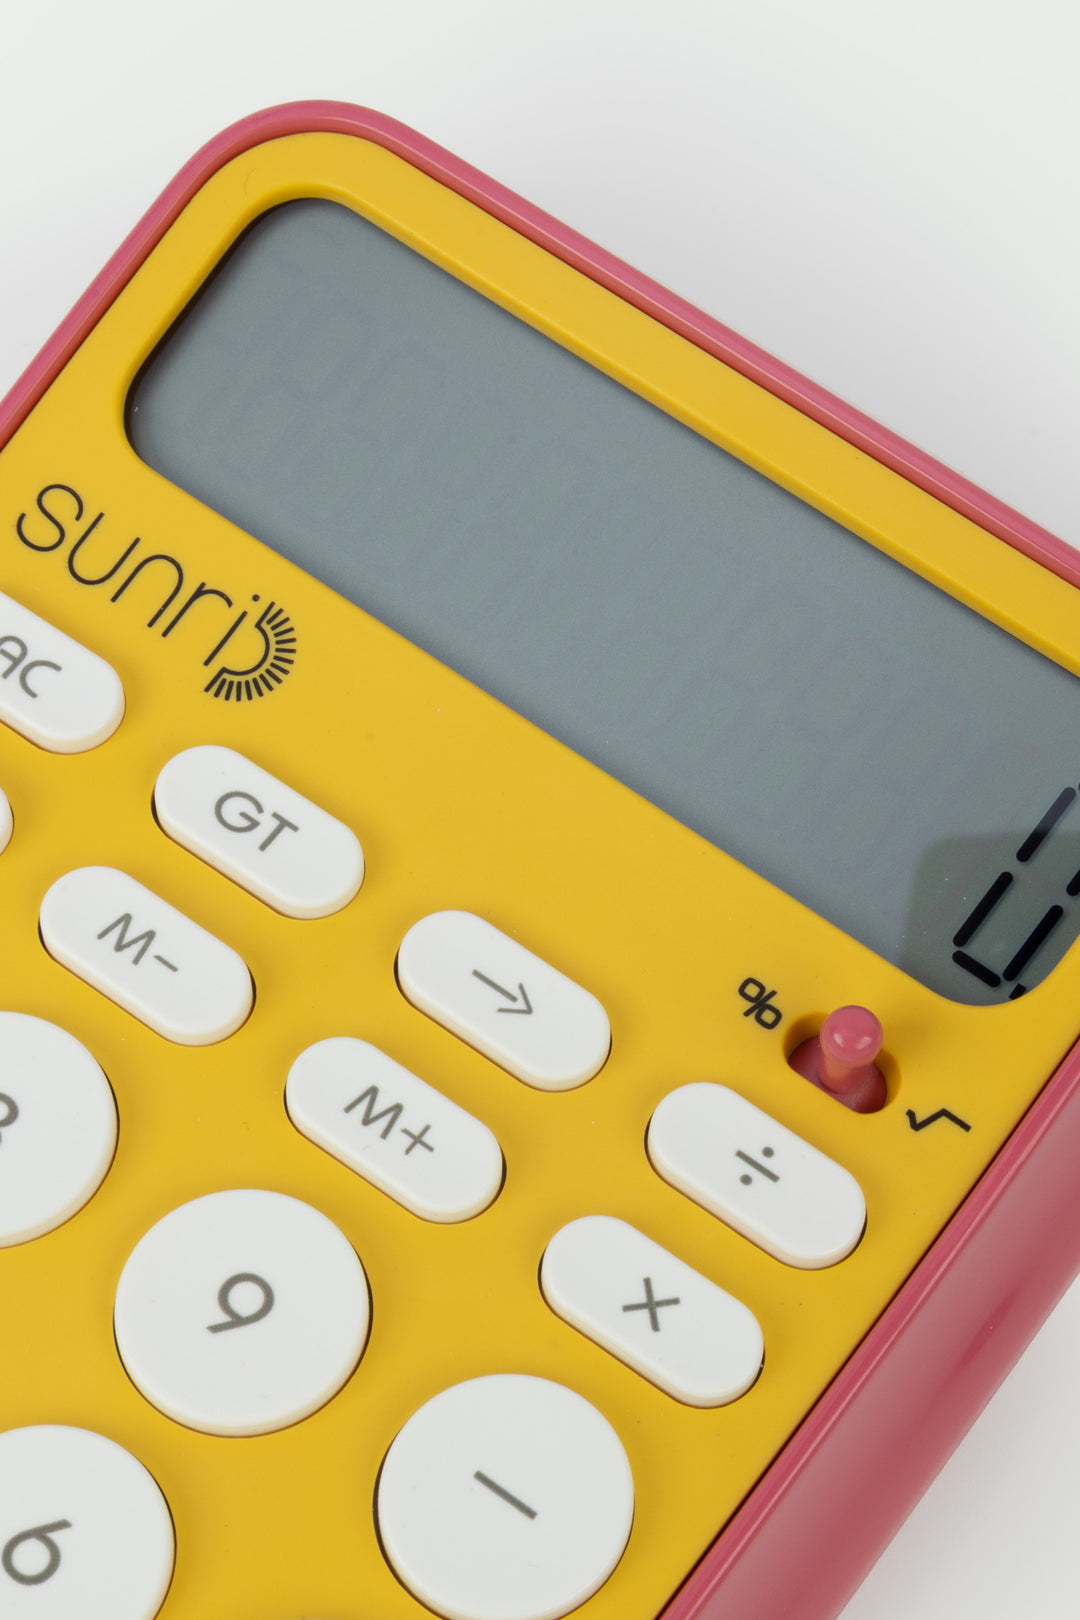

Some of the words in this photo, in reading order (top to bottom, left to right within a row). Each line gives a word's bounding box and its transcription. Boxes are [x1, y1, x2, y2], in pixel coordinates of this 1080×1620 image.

[214, 791, 299, 852] GT
[97, 912, 179, 973] M-
[738, 977, 782, 1030] %
[343, 1085, 434, 1155] M+
[206, 1272, 275, 1334] 9
[1, 1519, 72, 1586] 6
